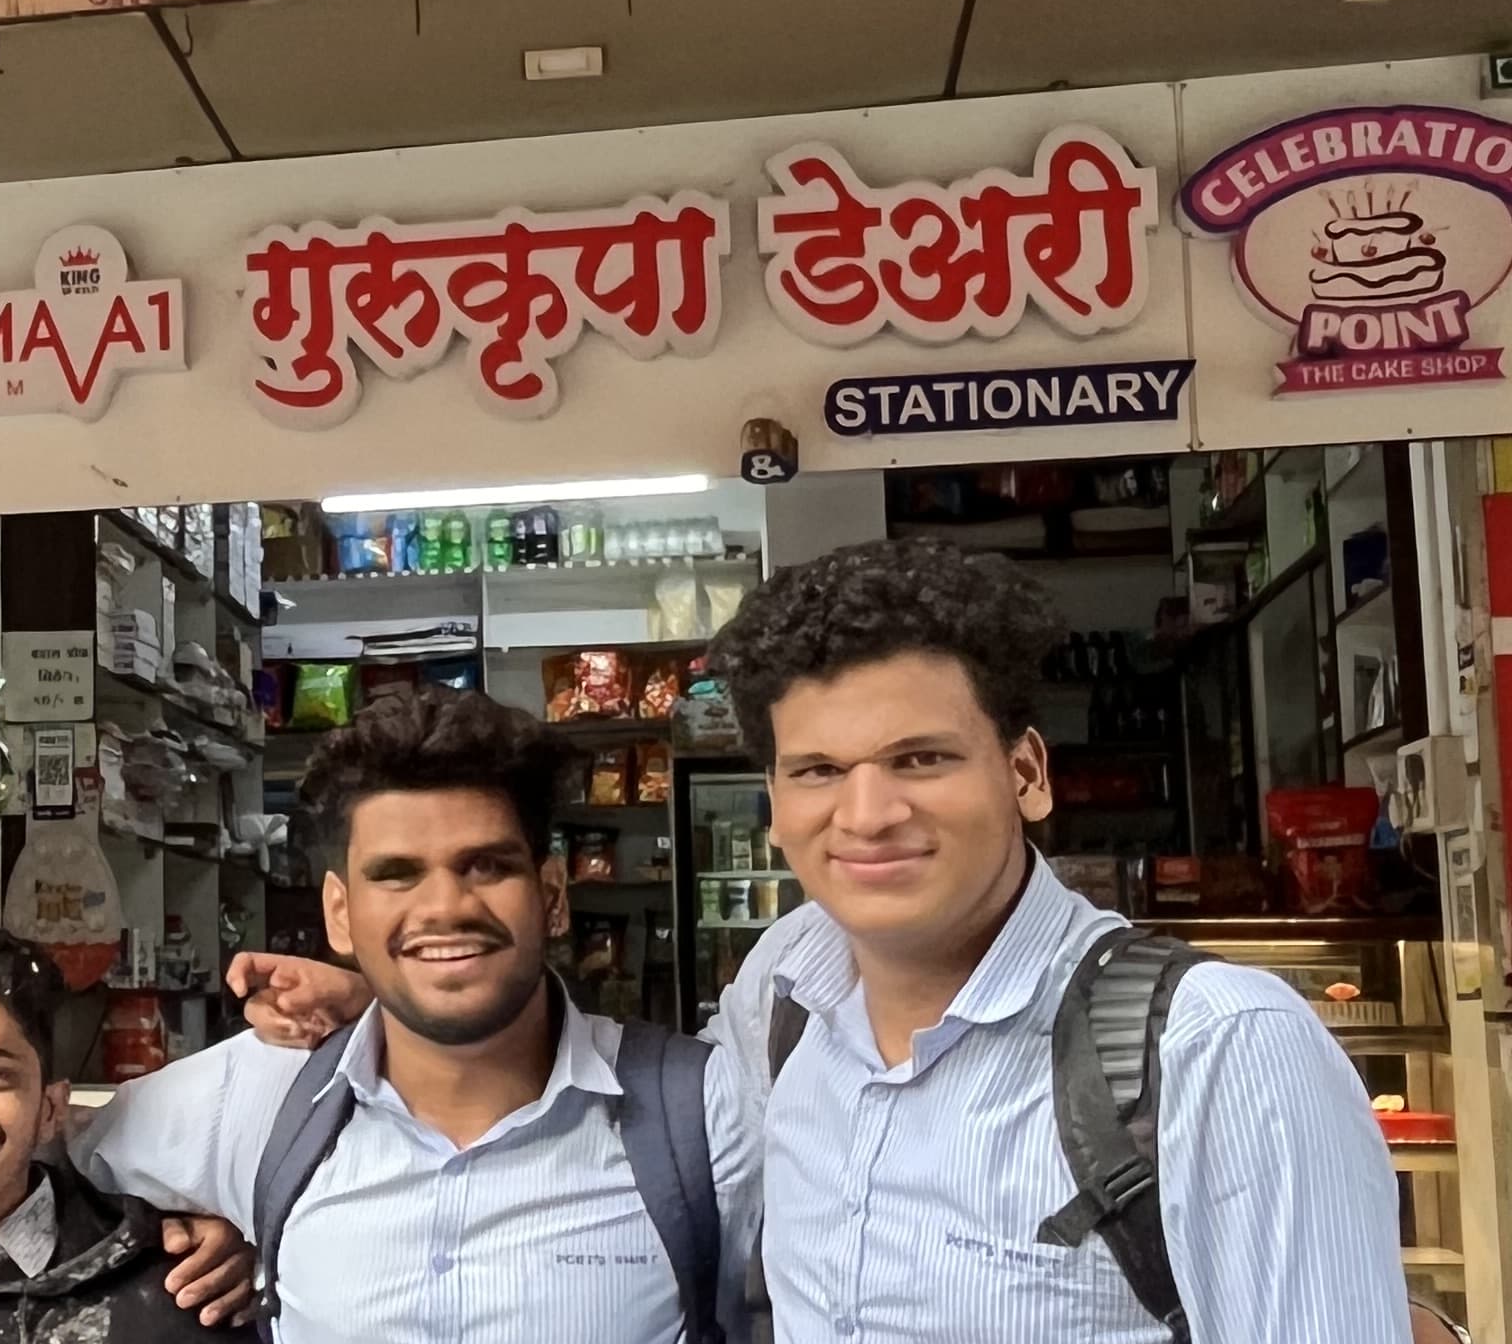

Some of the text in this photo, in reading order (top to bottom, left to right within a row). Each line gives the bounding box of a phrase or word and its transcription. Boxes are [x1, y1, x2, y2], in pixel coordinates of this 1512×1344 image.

[1200, 118, 1512, 217] CELEBRATIO
[773, 140, 1142, 326] डेअरी
[59, 267, 101, 286] KING
[1306, 296, 1463, 351] POINT
[1301, 355, 1487, 385] THE CAKE SHOP
[834, 368, 1182, 430] STATIONARY
[748, 454, 785, 481] &
